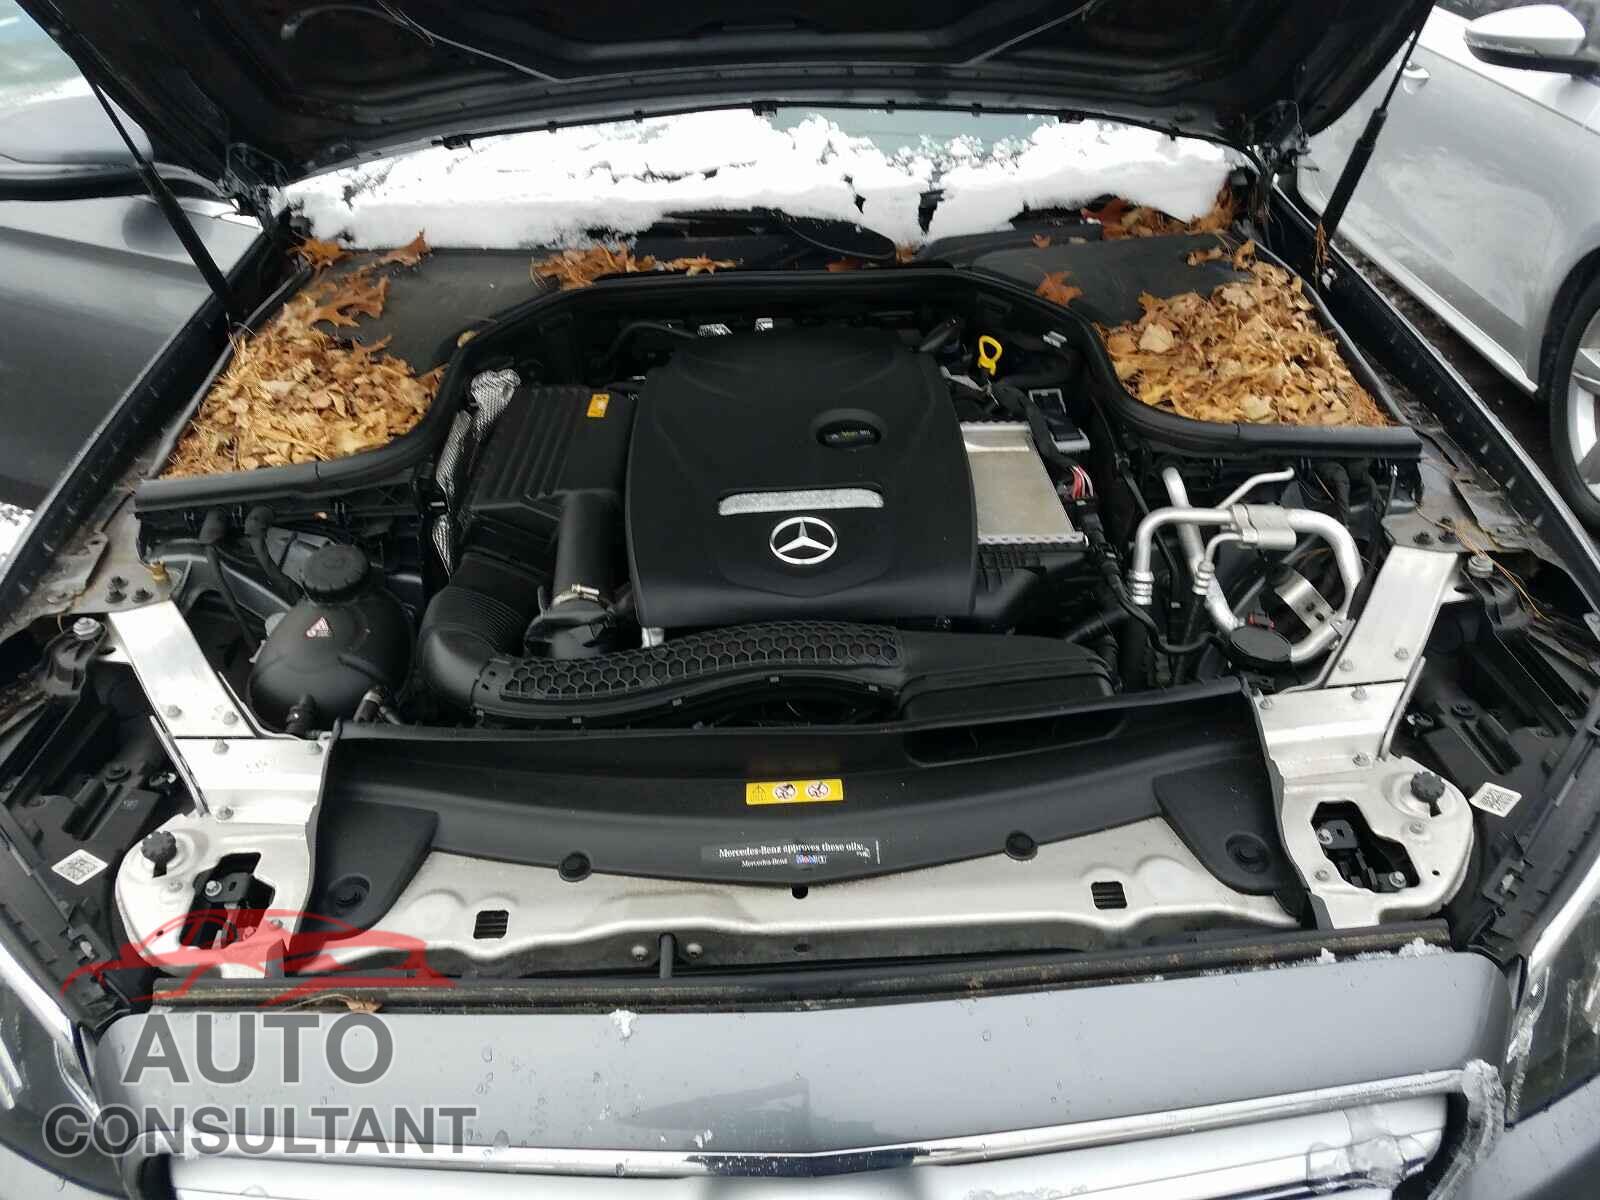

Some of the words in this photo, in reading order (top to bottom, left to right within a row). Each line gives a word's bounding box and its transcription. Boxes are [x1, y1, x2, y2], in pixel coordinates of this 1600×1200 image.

[719, 844, 781, 858] Mercedes-Benz
[783, 843, 820, 855] approves
[822, 841, 844, 852] these
